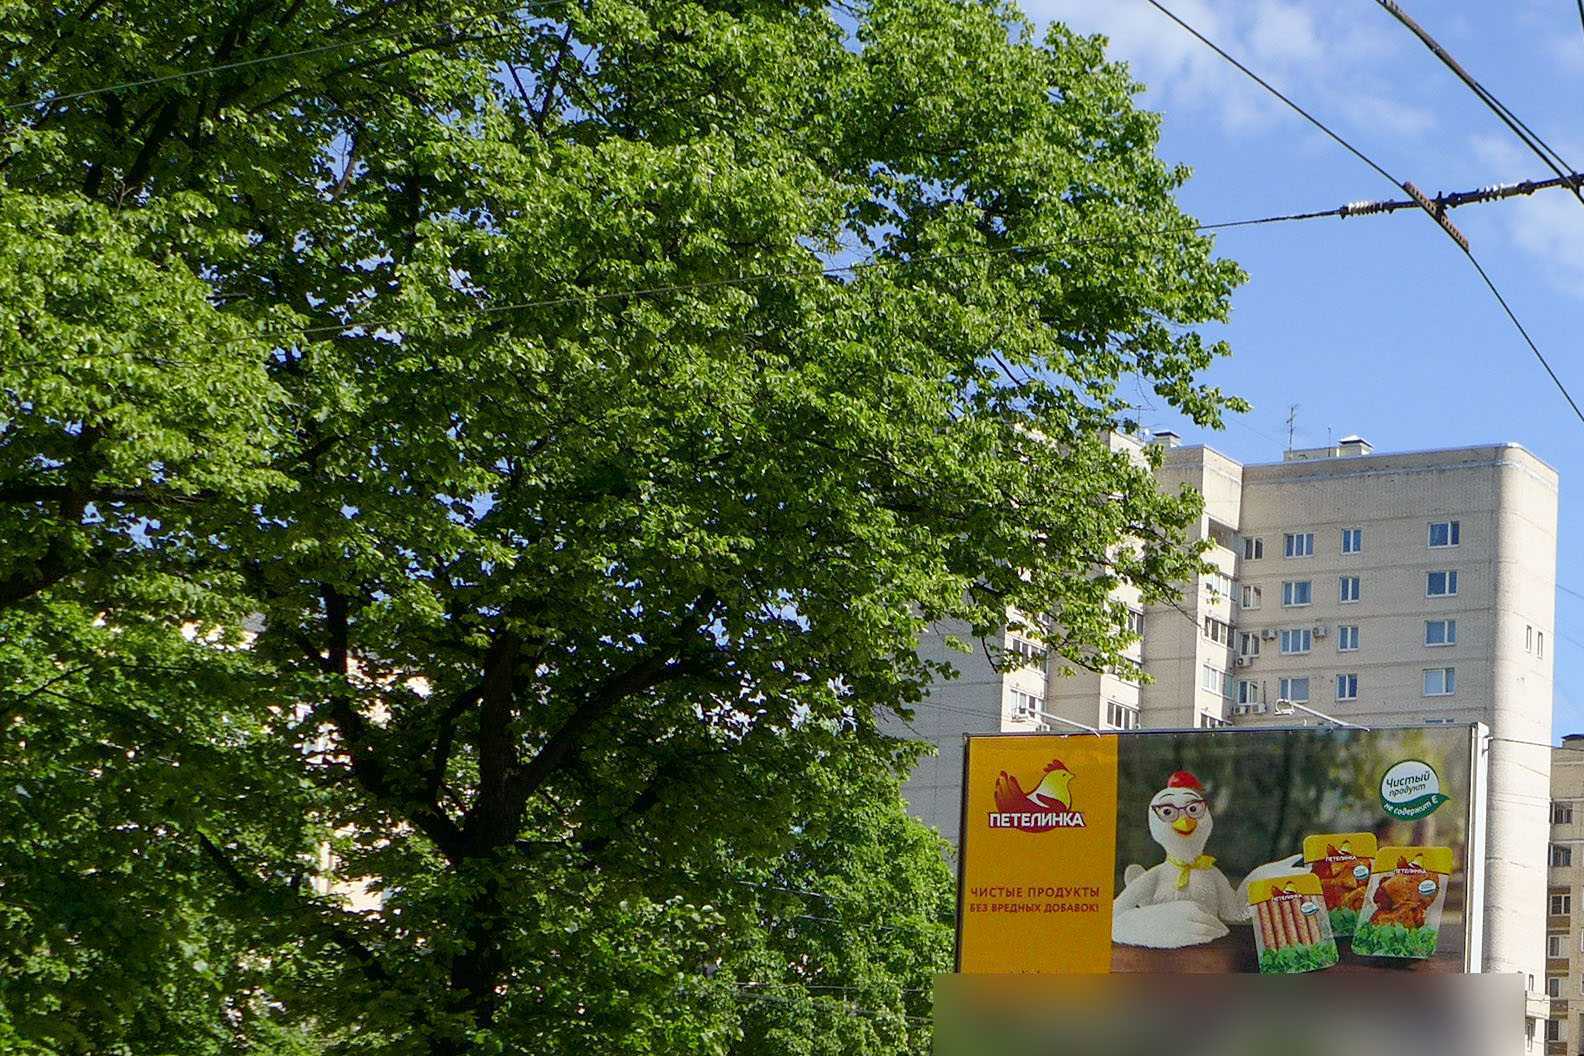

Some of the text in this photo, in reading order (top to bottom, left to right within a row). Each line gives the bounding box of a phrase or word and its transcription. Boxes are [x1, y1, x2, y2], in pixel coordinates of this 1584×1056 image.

[1386, 771, 1430, 788] Чистый
[1389, 784, 1426, 797] продукт
[989, 812, 1085, 828] ПЕТЕЛИНКА
[971, 887, 1100, 898] ЧИСТЫЕ ПРОДУКТЫ
[970, 903, 1100, 913] БЕЗ ВРЕДНЫХ ДОБАВОК!
